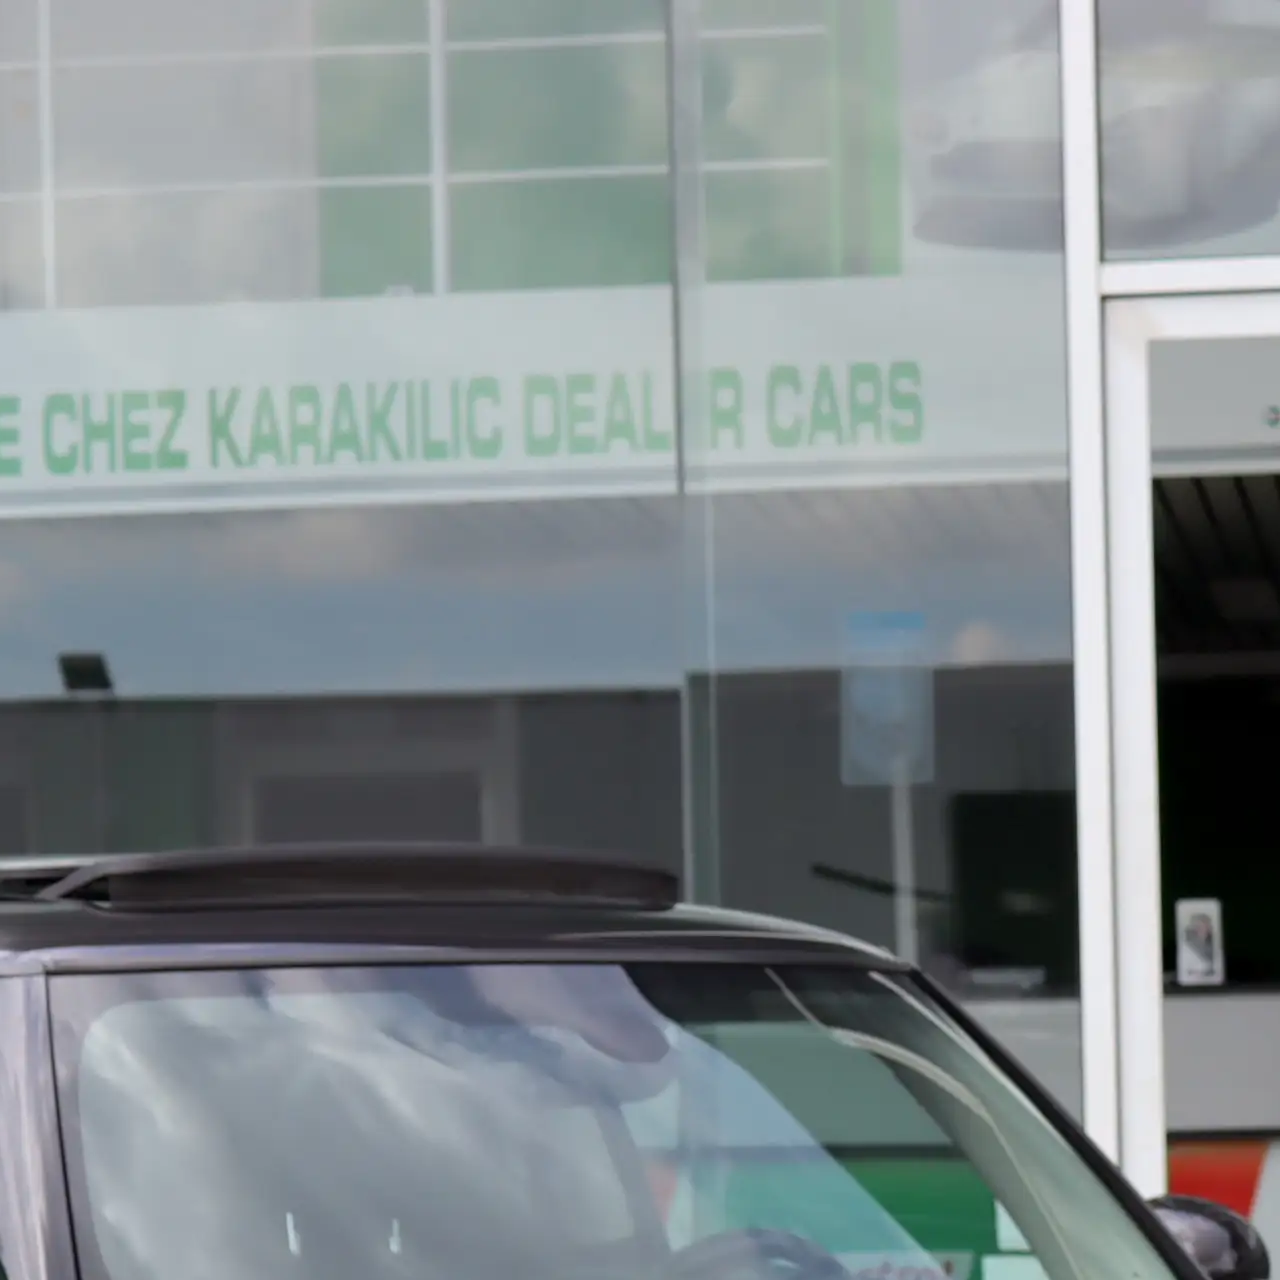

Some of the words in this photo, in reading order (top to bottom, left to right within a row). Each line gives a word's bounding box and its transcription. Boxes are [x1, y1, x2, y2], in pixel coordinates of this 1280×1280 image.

[42, 390, 189, 476] CHEZ
[207, 375, 504, 469] KARAKILIC
[523, 366, 745, 457] DEALR
[766, 360, 925, 448] CARS
